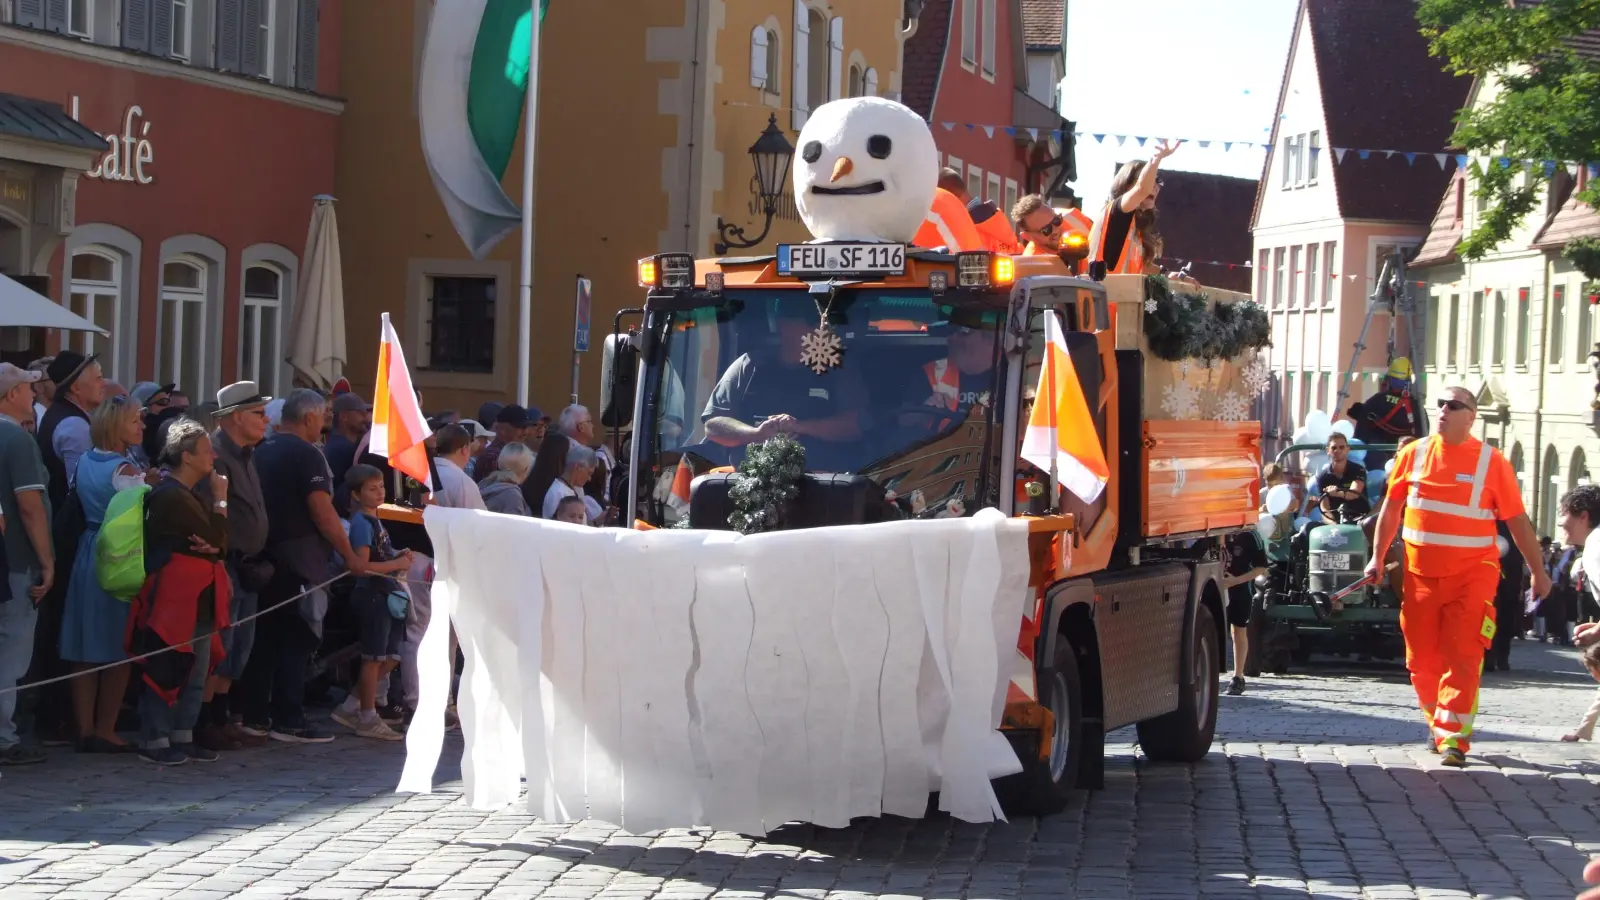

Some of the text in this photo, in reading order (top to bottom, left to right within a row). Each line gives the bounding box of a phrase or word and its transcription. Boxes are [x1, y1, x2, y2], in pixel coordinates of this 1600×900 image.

[790, 248, 825, 268] FEU
[840, 247, 863, 268] SF
[868, 247, 902, 268] 116
